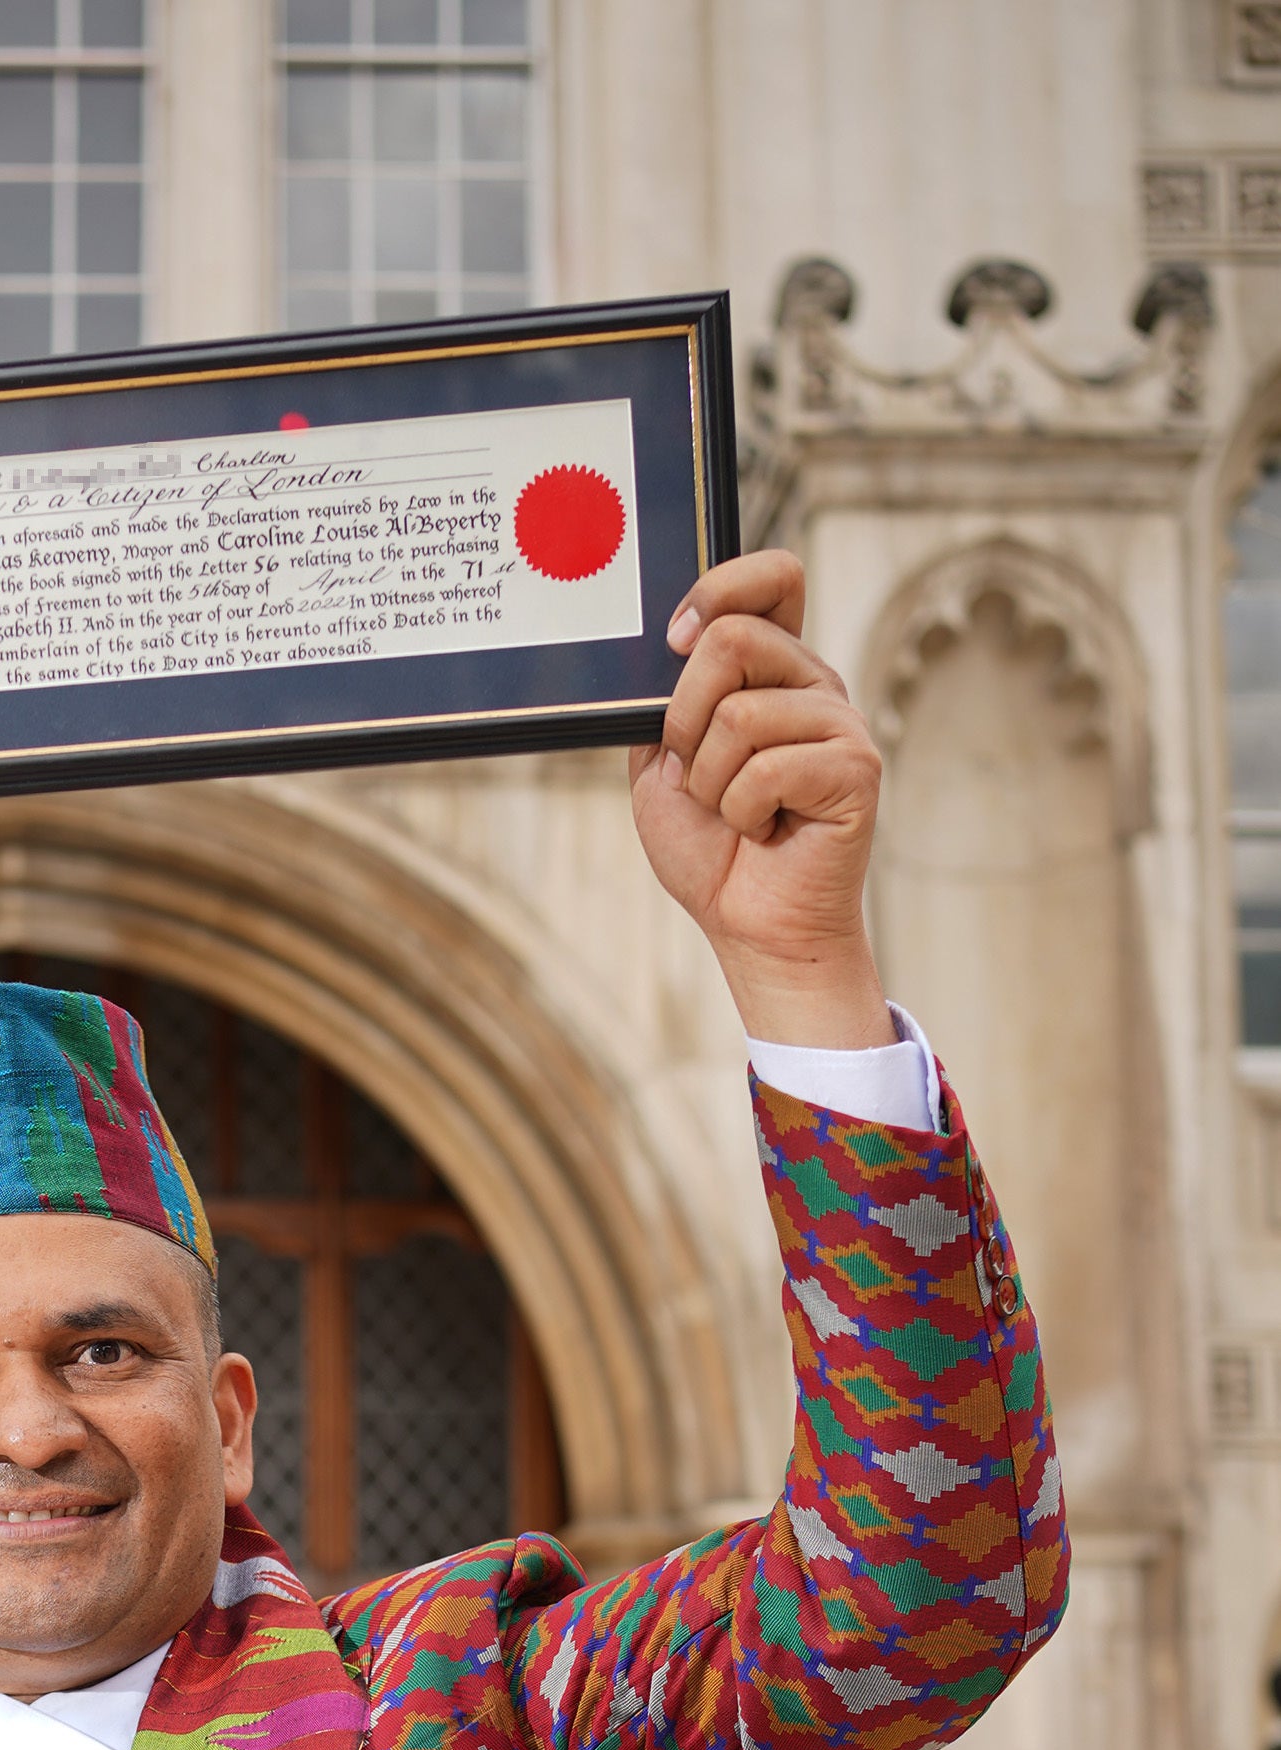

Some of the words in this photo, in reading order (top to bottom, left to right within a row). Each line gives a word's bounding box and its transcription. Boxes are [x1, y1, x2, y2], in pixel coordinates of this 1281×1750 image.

[192, 449, 297, 474] Charlton
[12, 521, 85, 548] aforesaid
[91, 518, 121, 538] and
[127, 514, 169, 535] made
[175, 512, 200, 533] the
[206, 505, 300, 528] Declaration
[307, 496, 372, 521] required
[379, 495, 399, 517] by
[405, 494, 442, 511] Law
[449, 489, 466, 507] in
[472, 485, 497, 507] the
[47, 493, 73, 509] a
[79, 486, 191, 525] Citizen
[200, 476, 233, 512] of
[236, 463, 373, 502] London
[0, 575, 24, 596] the
[29, 570, 66, 591] book
[71, 565, 122, 591] signed
[126, 562, 163, 584] with
[168, 560, 193, 582] the
[198, 558, 248, 577] Letter
[253, 554, 280, 575] 56
[289, 548, 352, 569] relating
[357, 547, 375, 563] to
[379, 542, 405, 563] the
[410, 535, 500, 563] purchasing
[121, 543, 174, 562] Mayor
[179, 535, 210, 555] and
[217, 524, 305, 552] Caroline
[309, 518, 380, 545] Louise
[14, 596, 30, 619] of
[34, 596, 102, 617] Freemen
[105, 591, 123, 608] to
[126, 587, 154, 606] wit
[158, 584, 183, 605] the
[221, 579, 251, 600] day
[255, 576, 271, 598] of
[298, 564, 393, 596] April
[400, 565, 417, 583] in
[420, 561, 446, 583] the
[460, 559, 483, 581] 71
[58, 616, 78, 635] II.
[82, 612, 115, 633] And
[119, 612, 135, 629] in
[138, 609, 163, 630] the
[167, 611, 203, 629] year
[207, 603, 222, 625] of
[226, 606, 254, 621] our
[257, 597, 295, 618] Lord
[296, 592, 347, 613] 2022
[349, 594, 366, 610] In
[369, 589, 436, 609] Witness
[438, 579, 503, 604] whereof
[85, 636, 103, 657] of
[108, 634, 134, 655] the
[140, 630, 175, 651] said
[180, 629, 219, 649] City
[224, 626, 240, 644] is
[245, 621, 322, 644] hereunto
[327, 611, 388, 637] affixed
[392, 606, 446, 630] Dated
[452, 606, 469, 624] in
[474, 602, 502, 624] the
[6, 665, 32, 686] the
[38, 667, 80, 682] same
[86, 660, 124, 679] City
[129, 655, 156, 675] the
[161, 654, 199, 672] Day
[204, 648, 235, 668] and
[240, 649, 281, 667] Year
[287, 636, 377, 661] abovesaid.
